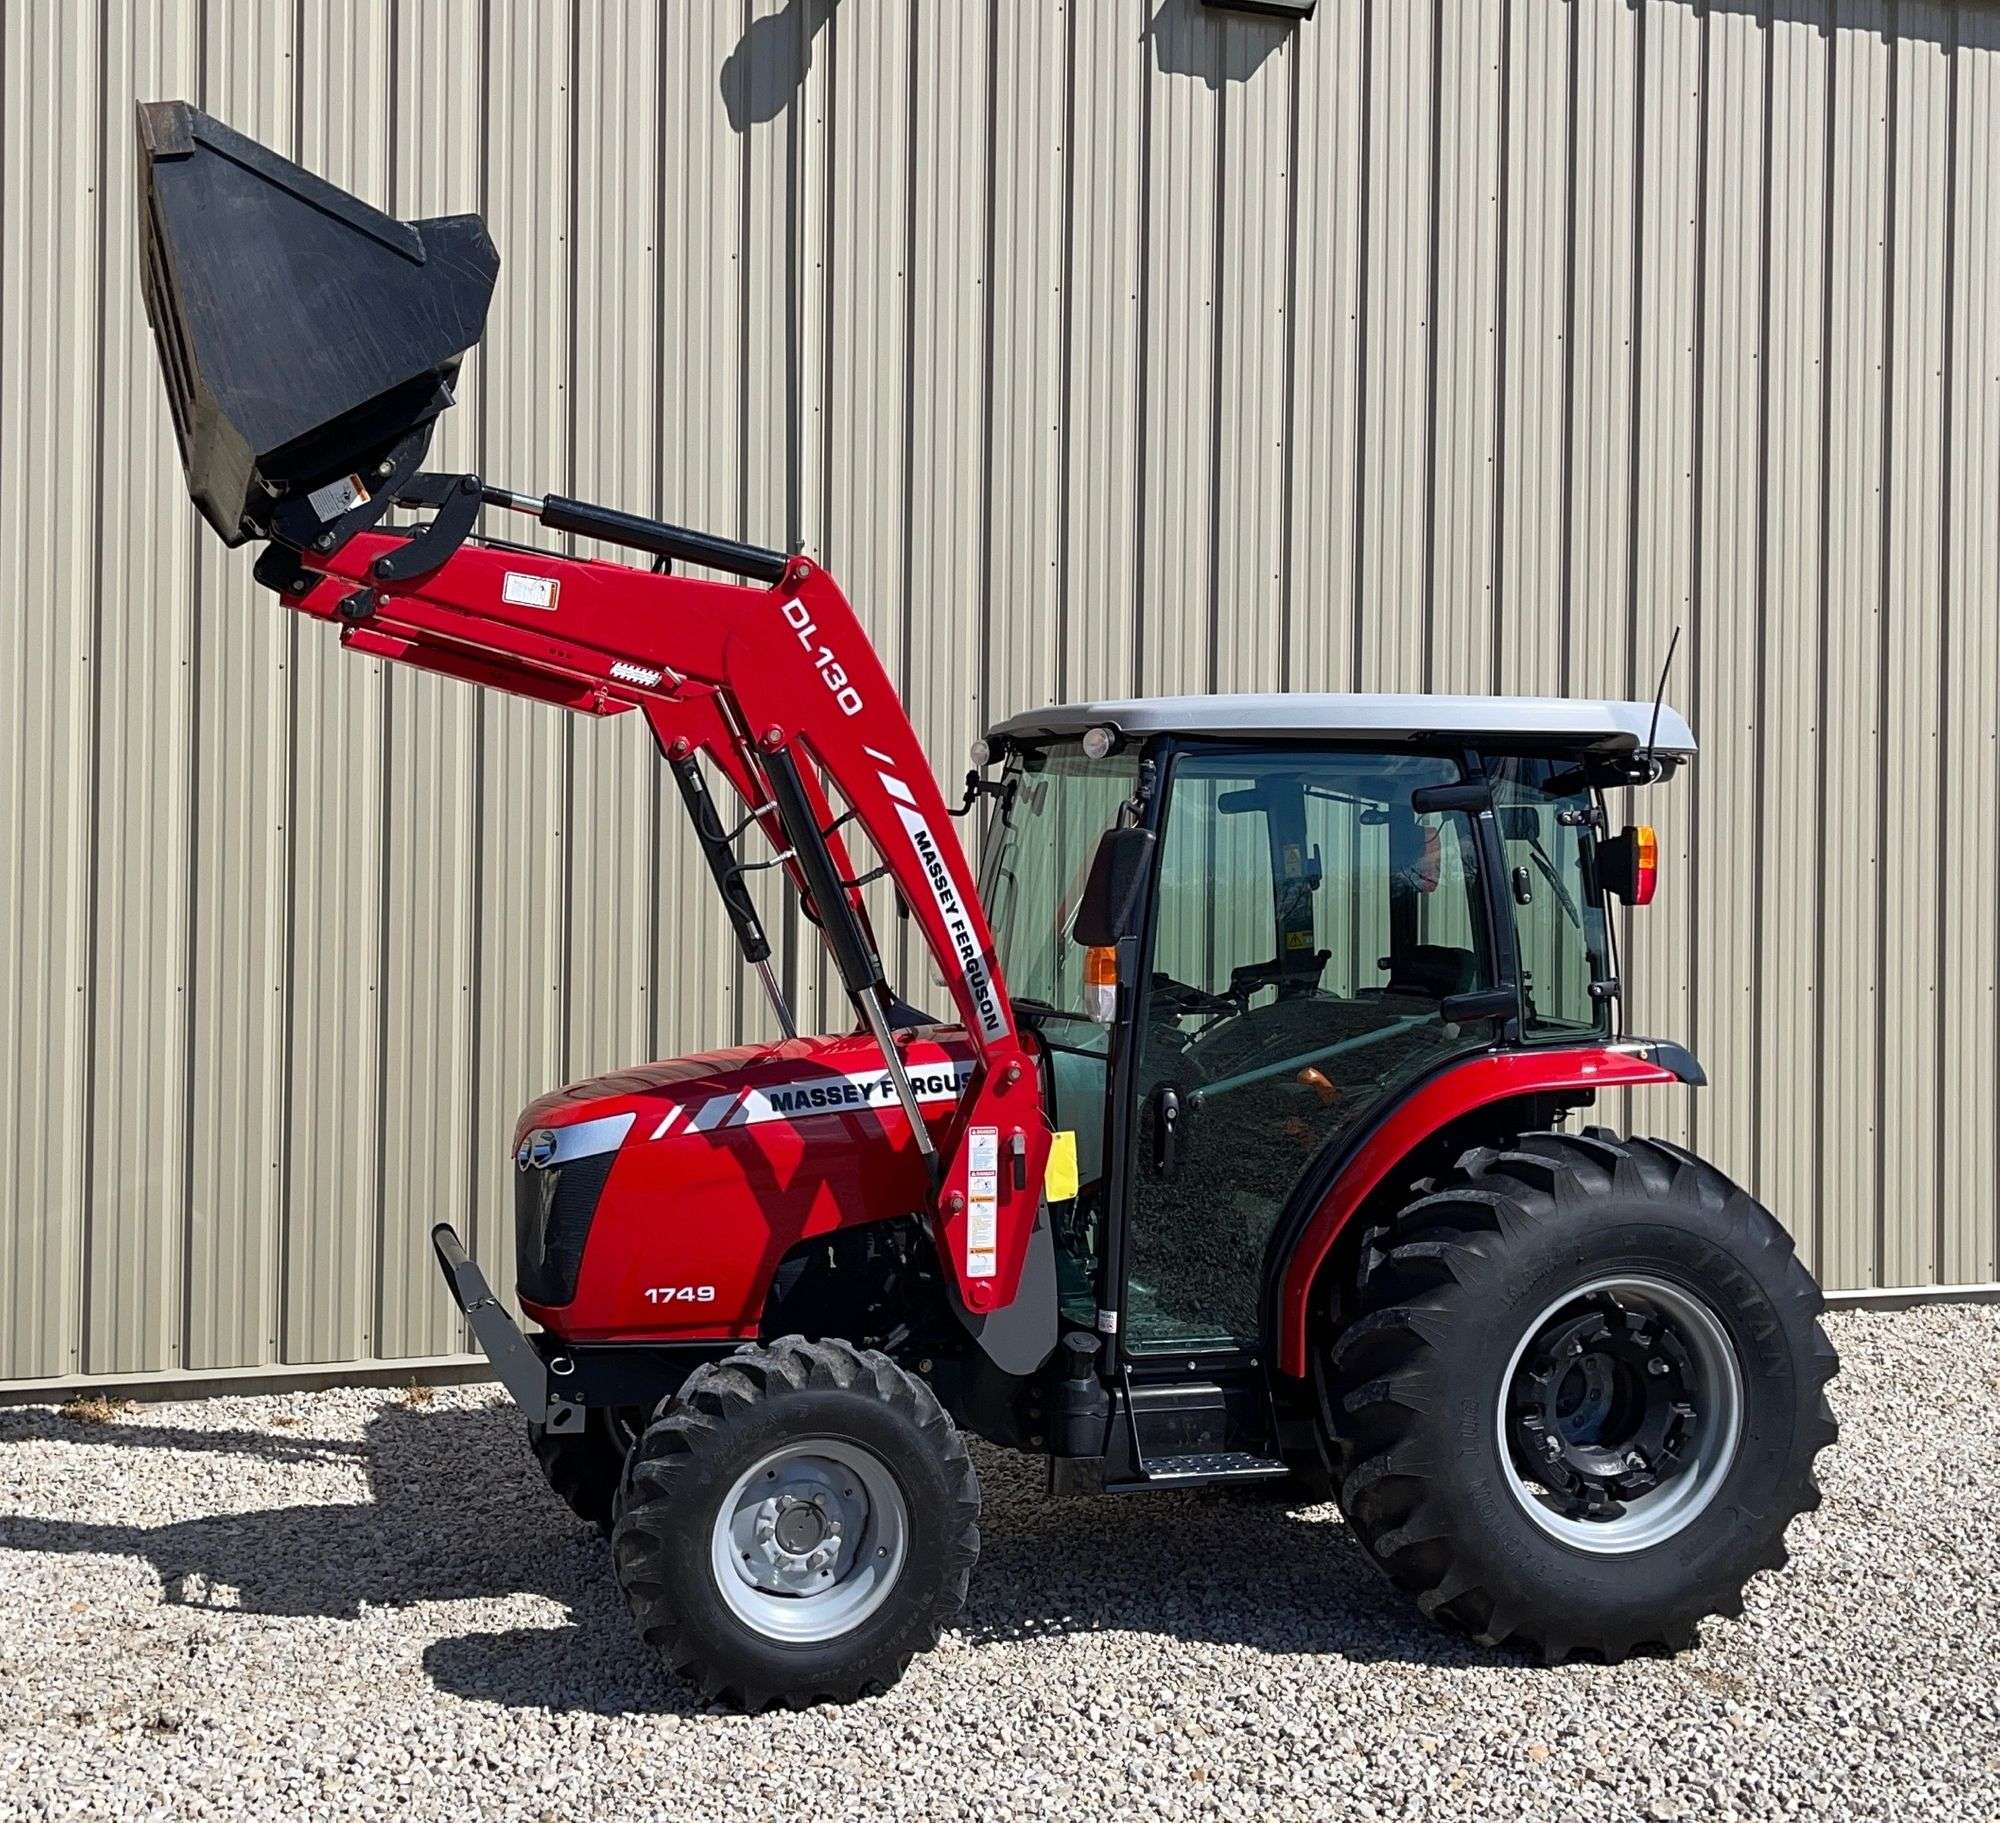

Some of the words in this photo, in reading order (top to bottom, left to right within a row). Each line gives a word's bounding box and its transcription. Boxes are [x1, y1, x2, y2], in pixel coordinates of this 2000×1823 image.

[781, 597, 863, 716] DL130
[913, 829, 959, 915] MASSEY
[950, 919, 1001, 1032] FERGUSON
[770, 1082, 874, 1112] MASSEY
[880, 1071, 972, 1099] FRGUS
[643, 1286, 716, 1304] 1749
